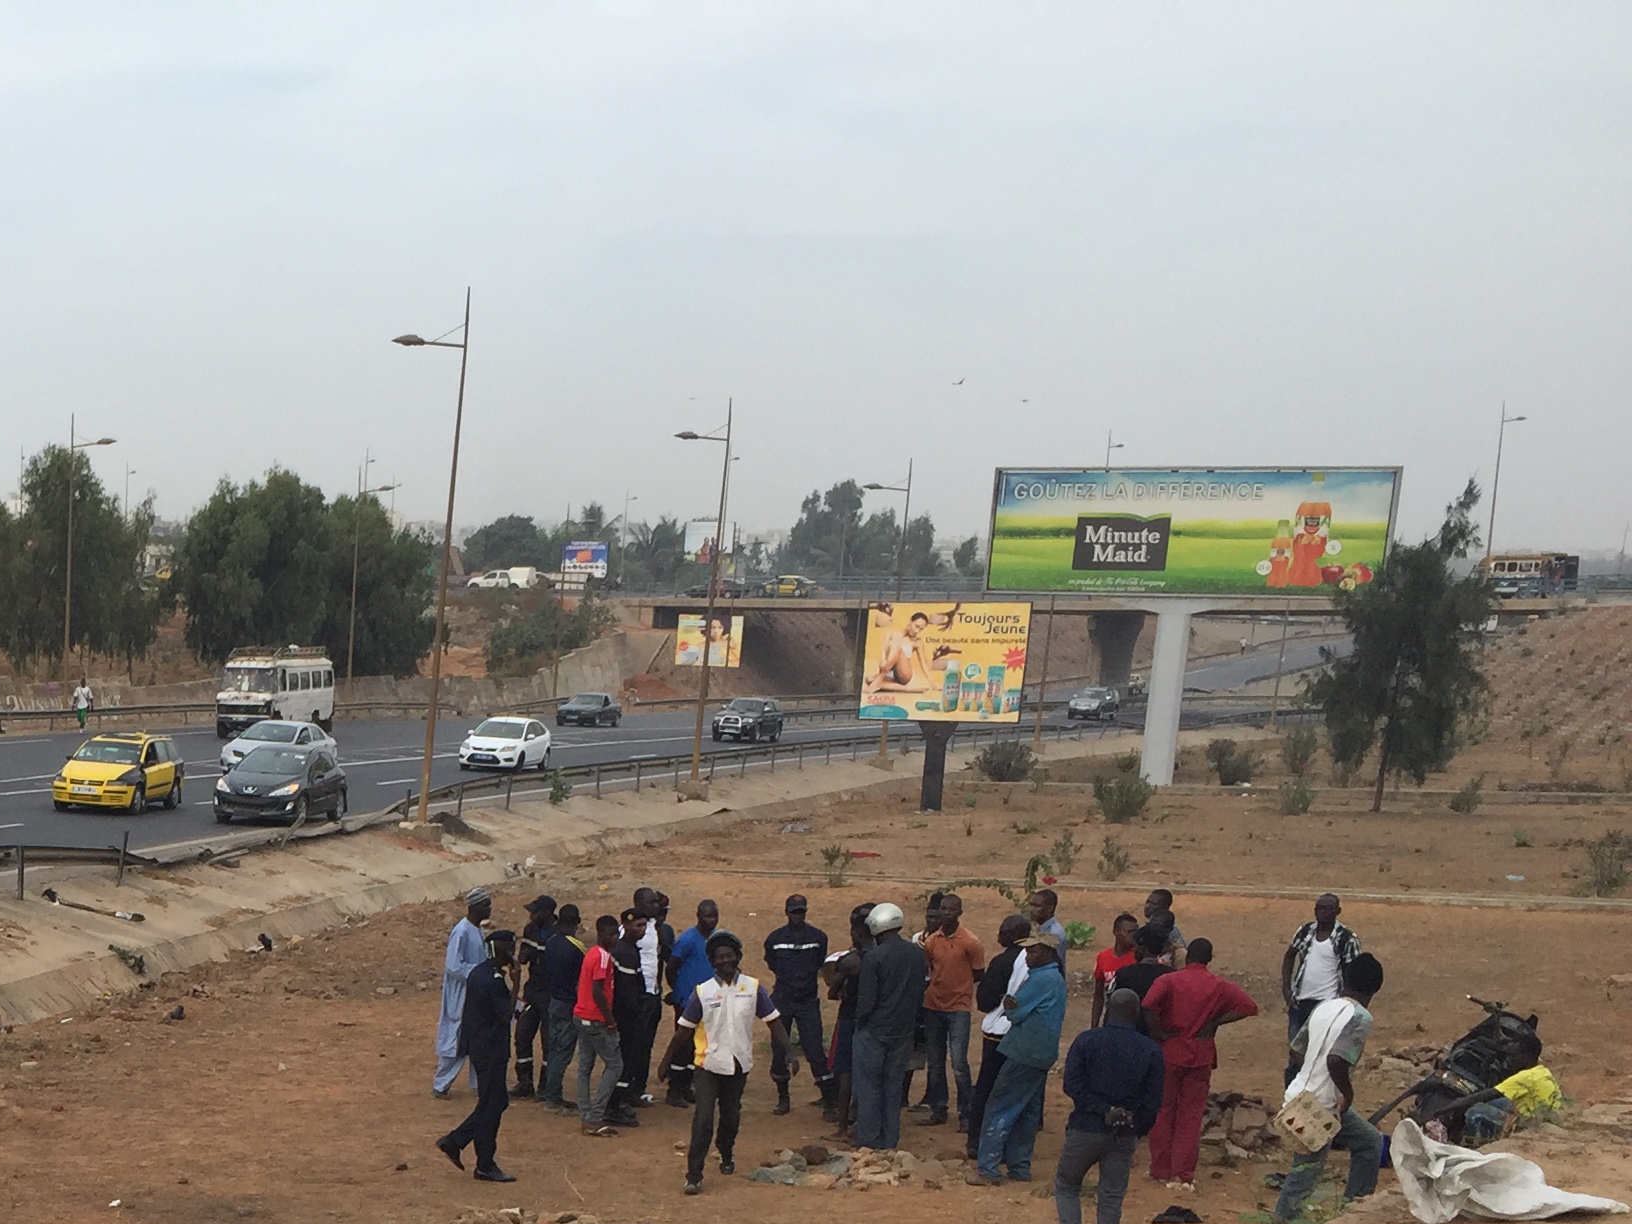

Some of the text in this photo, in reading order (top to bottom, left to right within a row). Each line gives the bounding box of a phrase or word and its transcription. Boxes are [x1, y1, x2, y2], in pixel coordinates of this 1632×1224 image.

[1013, 478, 1265, 500] GOÛTEZ LA DIFFÉRENCE
[1084, 525, 1161, 543] Minute
[1092, 544, 1148, 562] Maid
[957, 612, 1020, 626] Toujours
